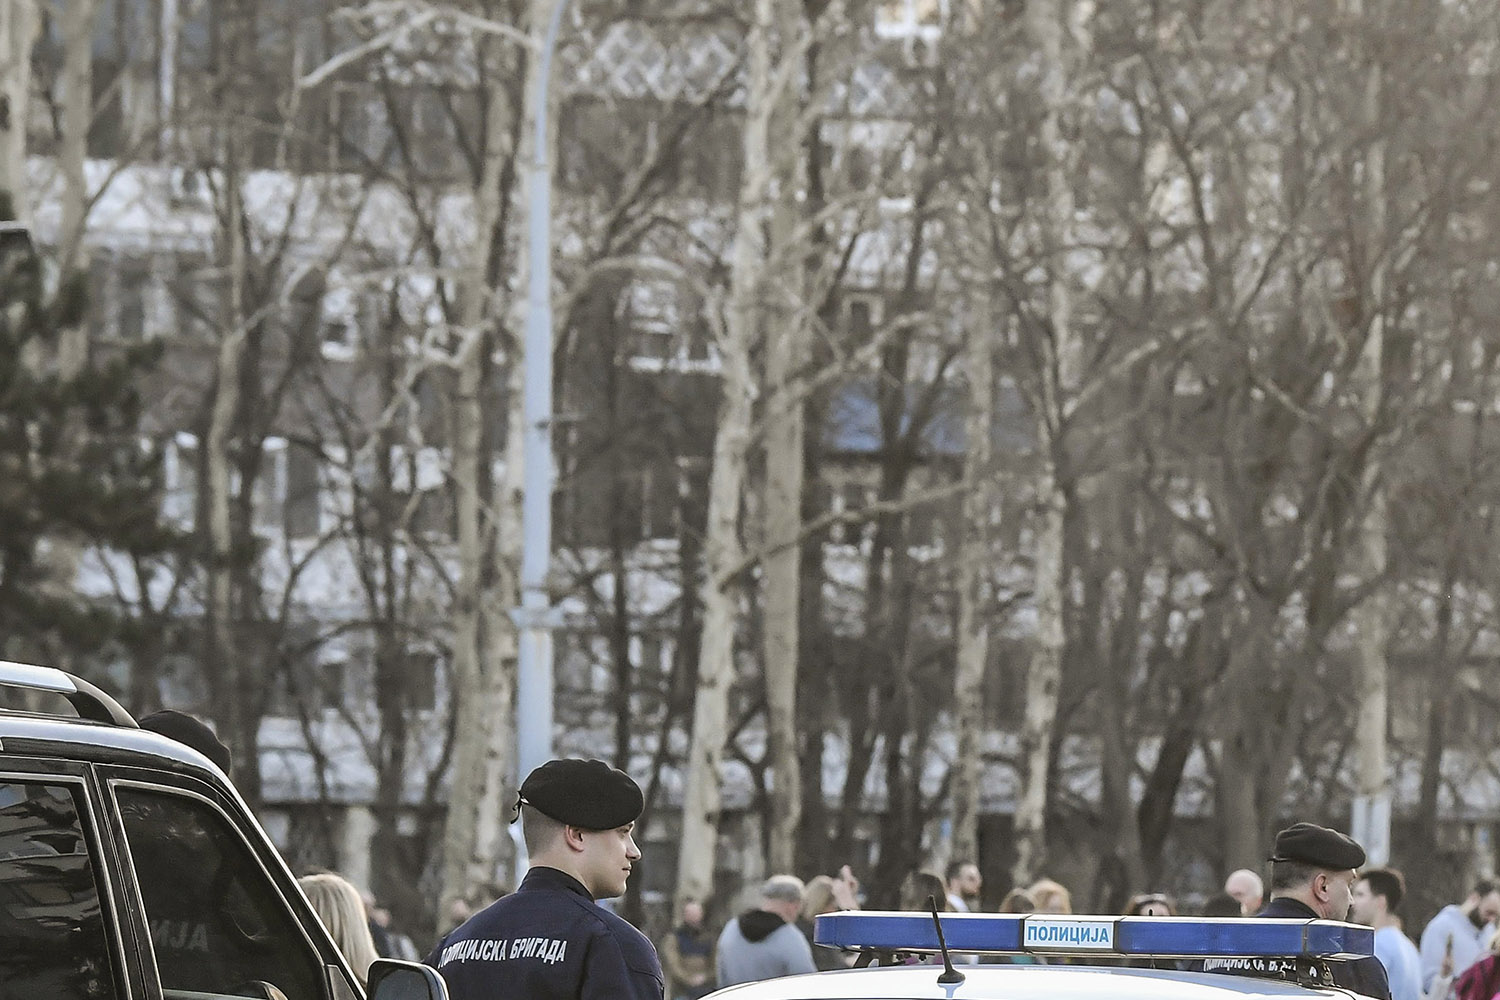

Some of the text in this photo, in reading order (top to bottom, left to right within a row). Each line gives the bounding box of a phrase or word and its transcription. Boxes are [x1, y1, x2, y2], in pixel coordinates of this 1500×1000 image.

[1028, 925, 1110, 945] ПОЛИЦИЈА
[437, 937, 568, 969] ПОЛИЦИЈСКА БРИГАДА
